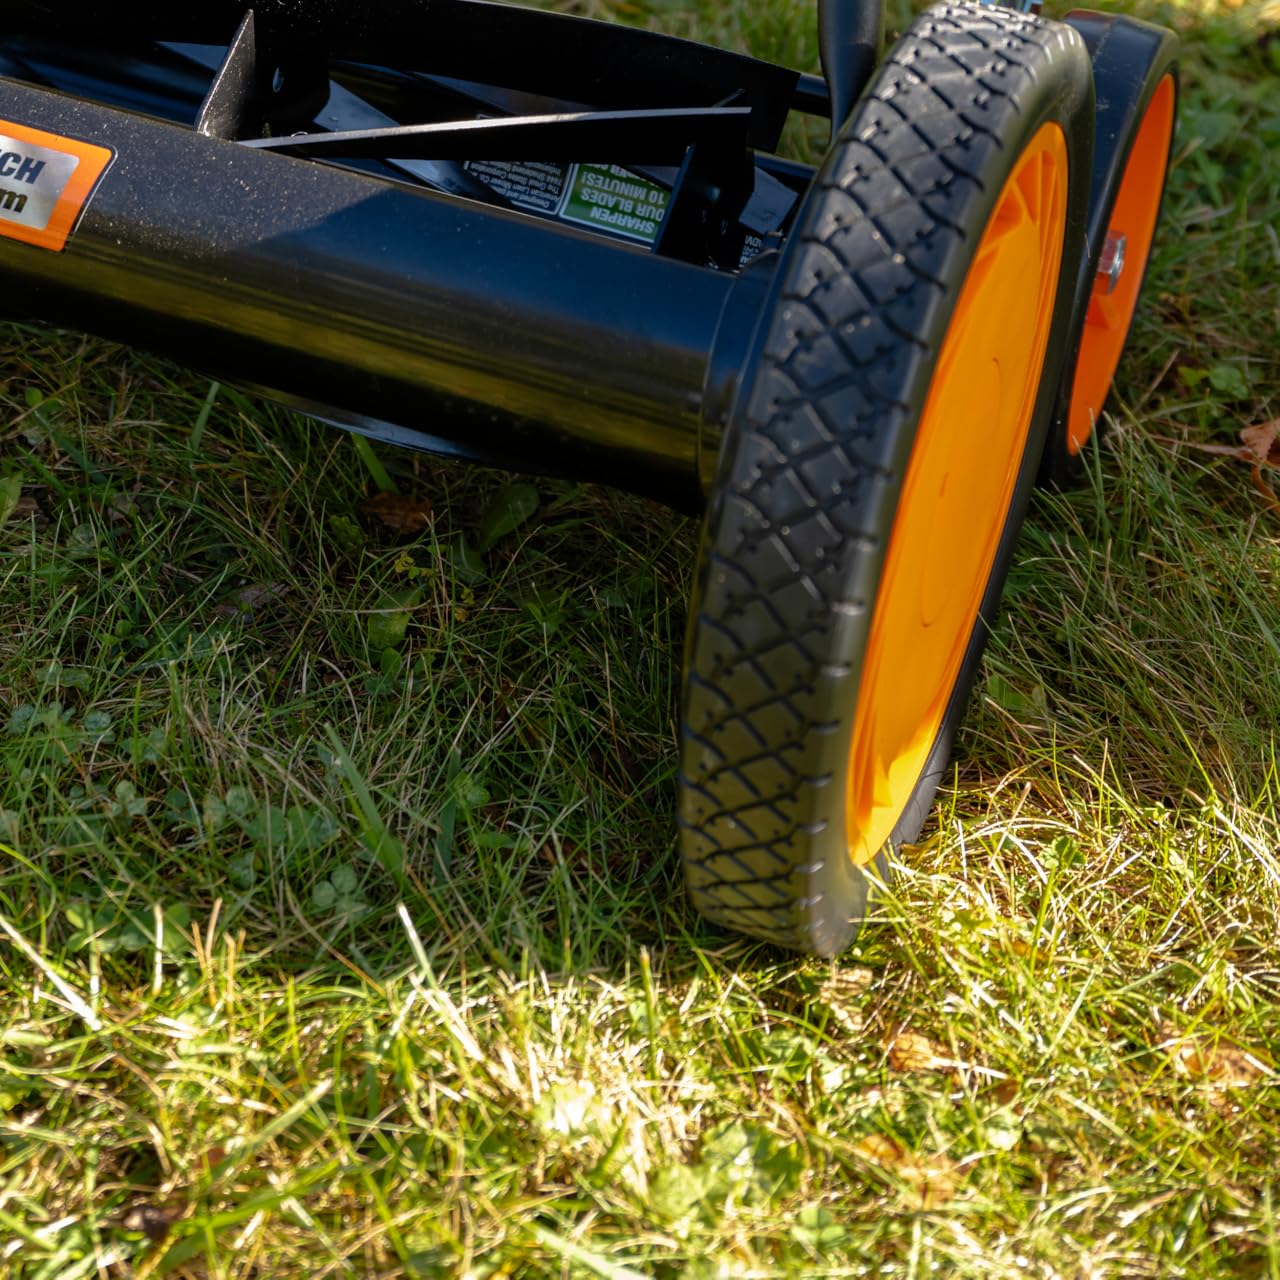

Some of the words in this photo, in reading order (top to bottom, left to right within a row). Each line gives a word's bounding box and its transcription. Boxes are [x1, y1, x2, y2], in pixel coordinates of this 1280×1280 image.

[580, 170, 647, 200] MINUTES!
[648, 189, 664, 204] 10
[579, 186, 634, 213] BLADES
[635, 202, 665, 221] OUR
[590, 205, 655, 233] SHARPEN
